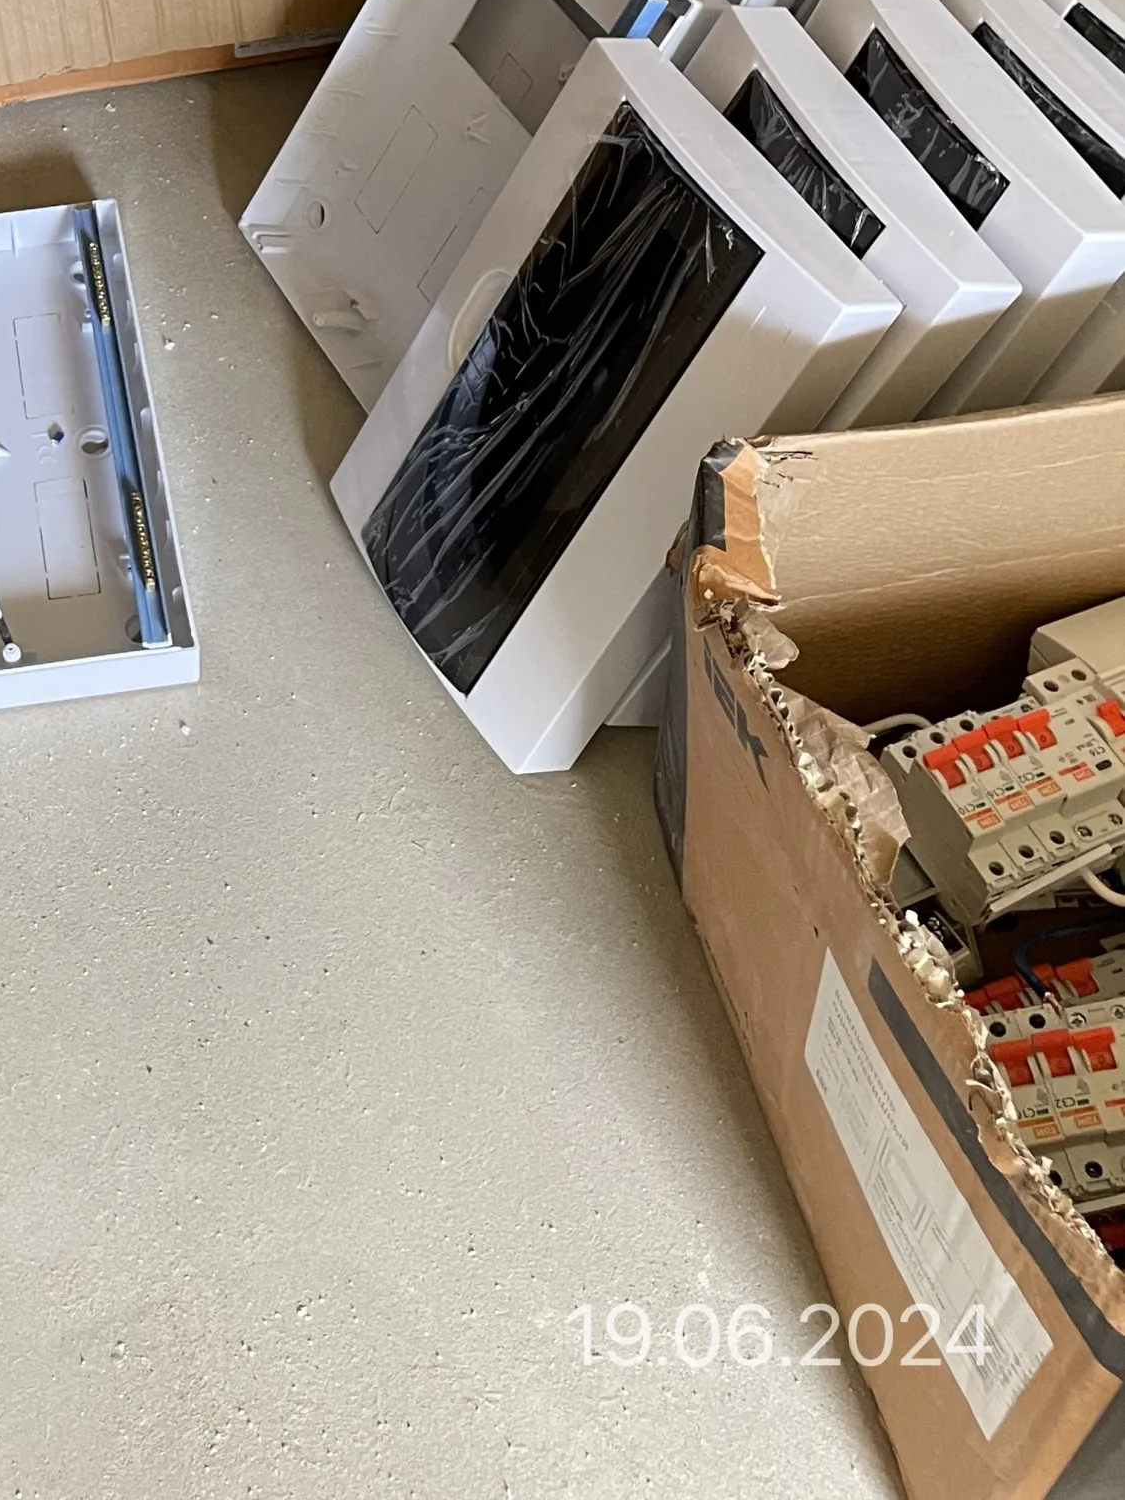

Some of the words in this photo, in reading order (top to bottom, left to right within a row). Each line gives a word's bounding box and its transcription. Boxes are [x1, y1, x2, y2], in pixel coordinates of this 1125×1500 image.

[703, 635, 769, 794] IEK
[1017, 772, 1035, 783] C32
[986, 787, 1005, 799] C16
[958, 803, 976, 815] C10
[1054, 1097, 1076, 1109] C32
